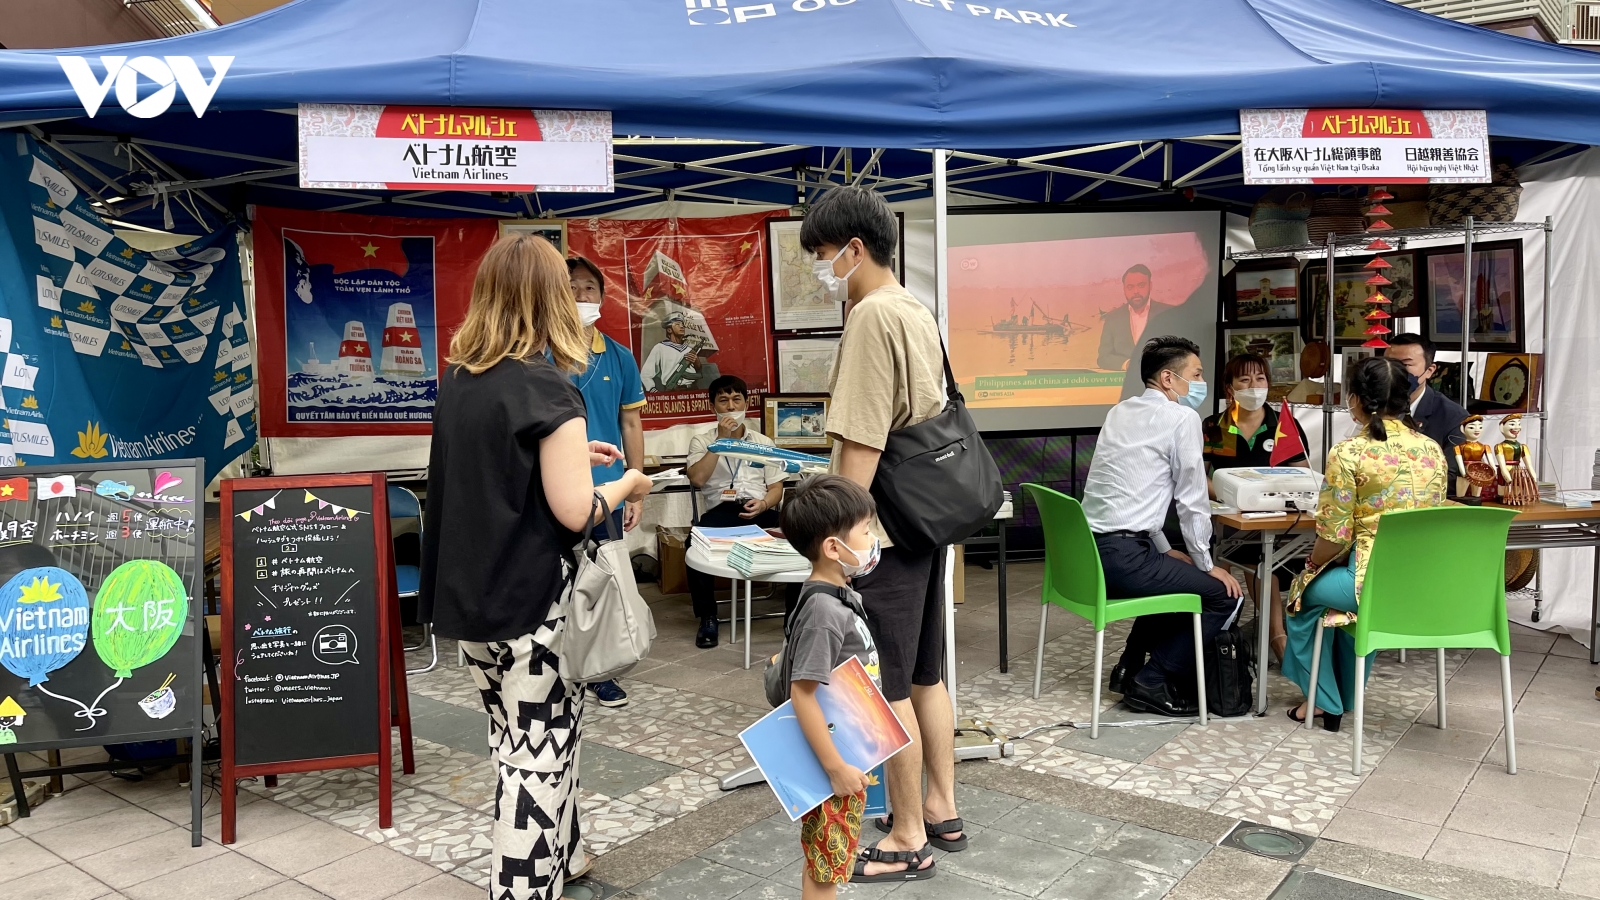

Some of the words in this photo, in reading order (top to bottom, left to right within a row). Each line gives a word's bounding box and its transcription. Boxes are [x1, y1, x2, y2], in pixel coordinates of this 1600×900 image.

[966, 4, 1078, 28] PARK
[401, 113, 518, 138] ベトナムマルシェ
[1321, 114, 1412, 135] ベトナムマルシェ
[403, 143, 517, 168] ベトナム航空
[1254, 147, 1382, 162] 在大阪ベトナム総領事館
[1405, 147, 1480, 162] 日越親善協会
[412, 167, 460, 180] Vietnam
[463, 168, 508, 180] Airlines
[1336, 164, 1348, 172] Nam
[1362, 164, 1380, 172] Osaka
[979, 378, 1021, 388] Philippines
[1022, 378, 1036, 386] and
[1070, 376, 1090, 384] odds
[56, 511, 95, 522] ハノイ
[50, 529, 98, 541] ホーチミン
[0, 606, 87, 632] Vietnam
[104, 599, 177, 635] 大阪
[0, 632, 86, 659] Airlines
